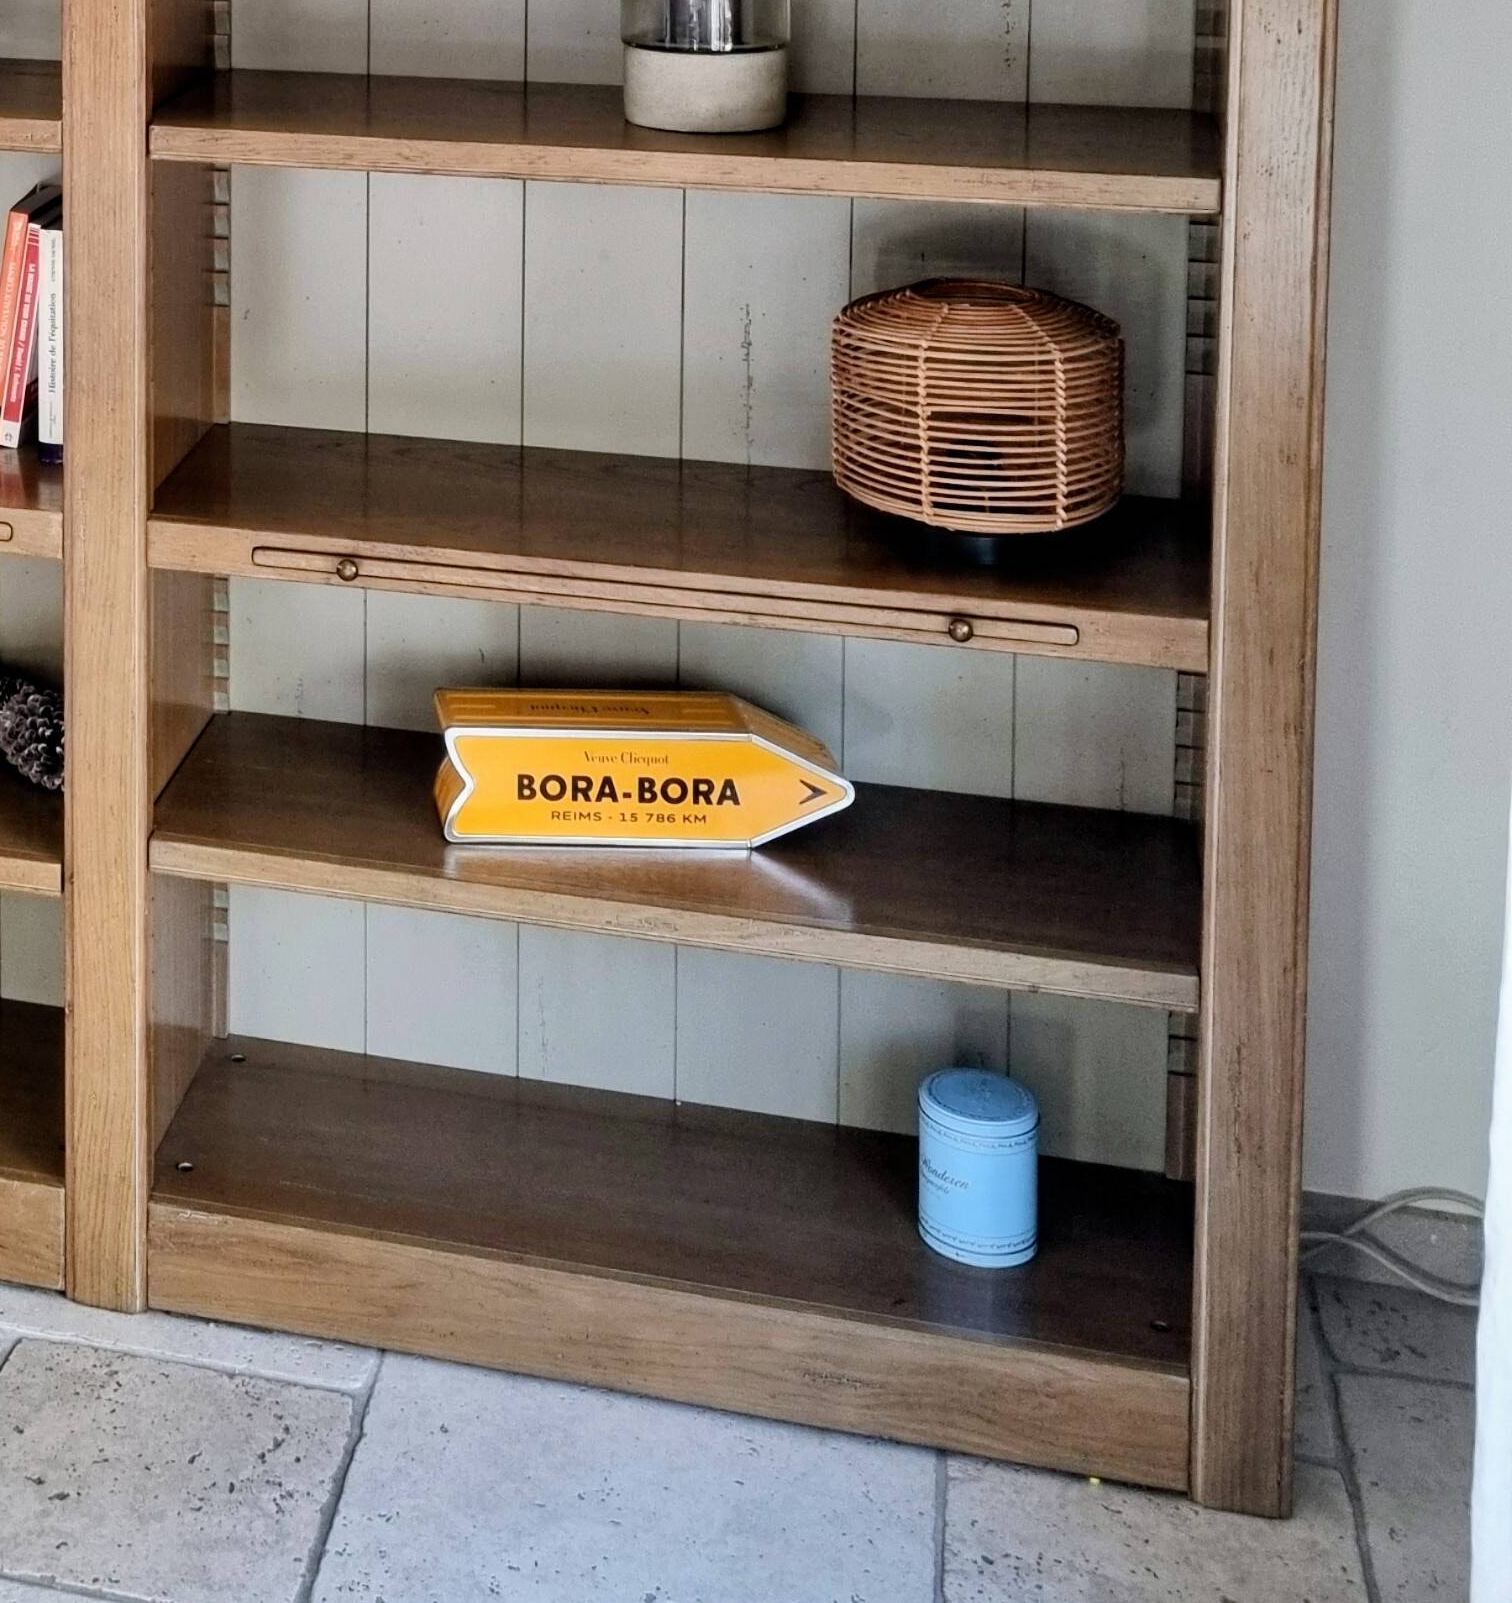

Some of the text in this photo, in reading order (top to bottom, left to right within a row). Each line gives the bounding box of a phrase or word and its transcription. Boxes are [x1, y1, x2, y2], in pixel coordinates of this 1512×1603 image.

[49, 345, 56, 356] de
[584, 751, 669, 767] Veuve Clicquot
[517, 774, 741, 806] BORA-BORA
[551, 810, 707, 824] REIMS 15 786 KM
